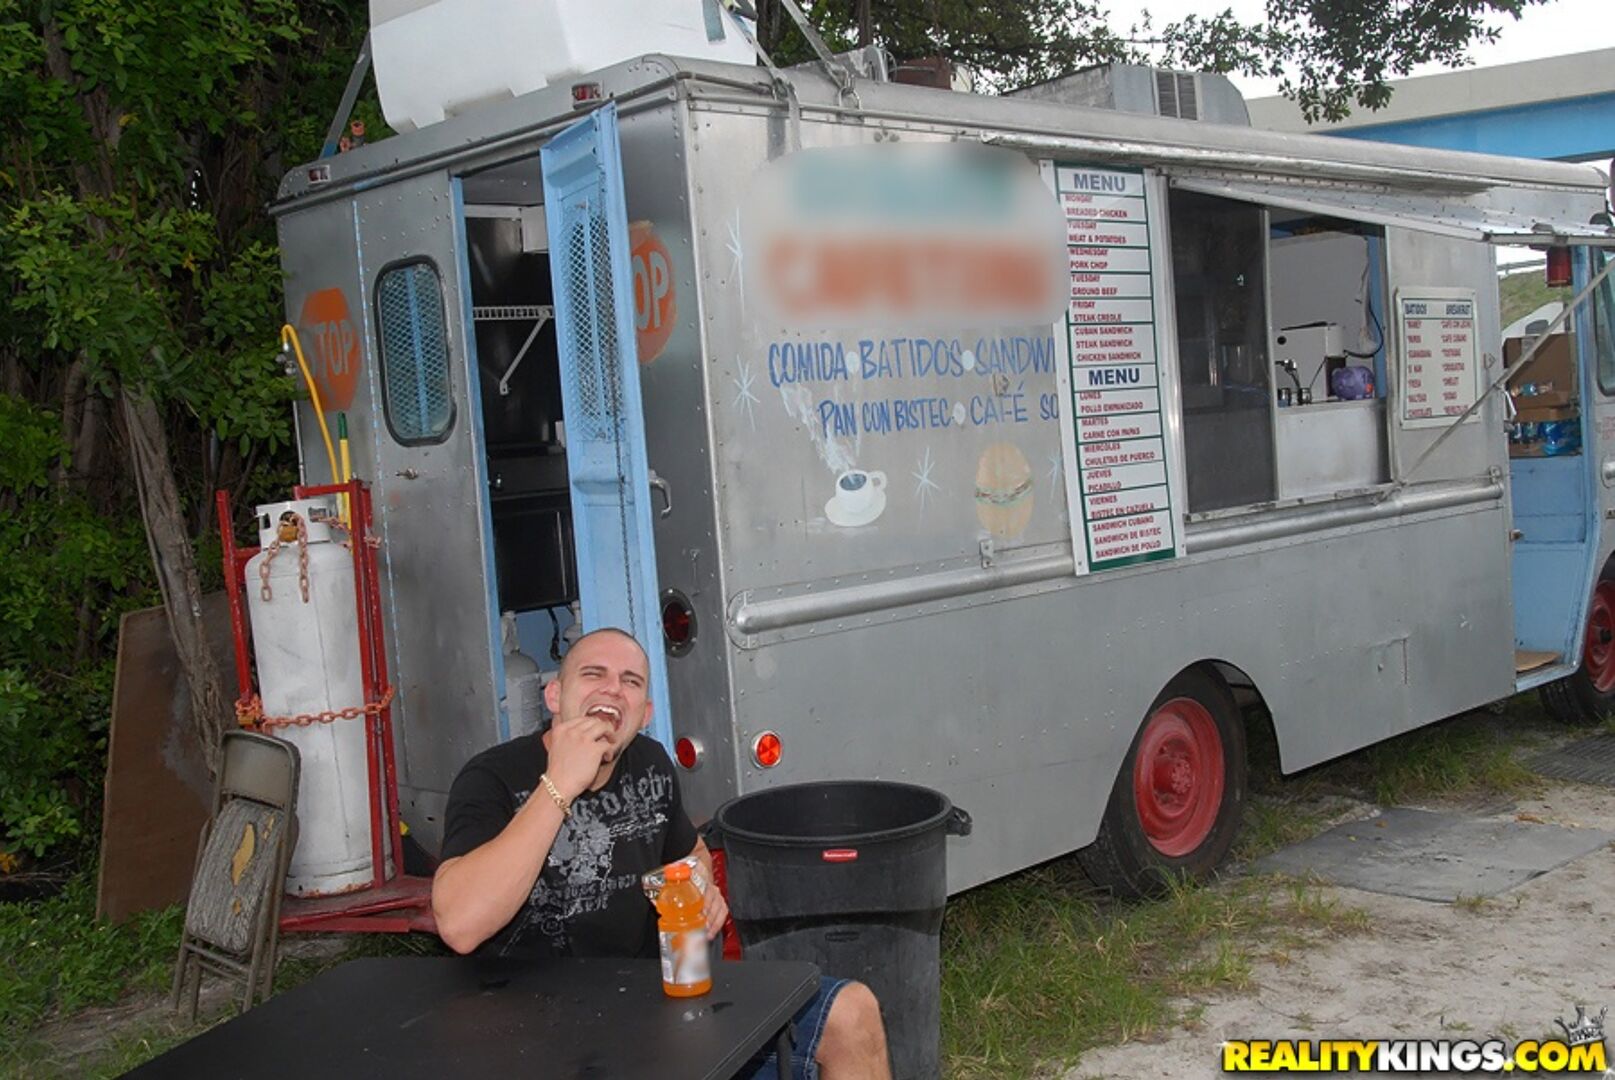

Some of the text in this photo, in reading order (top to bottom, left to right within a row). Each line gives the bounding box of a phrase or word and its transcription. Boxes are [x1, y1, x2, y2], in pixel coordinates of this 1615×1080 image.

[1073, 173, 1126, 192] MENU
[1099, 208, 1127, 218] CHICKEN
[1069, 234, 1086, 242] MEAT
[1069, 248, 1108, 256] WEDNESDAY
[1070, 260, 1108, 269] PORK CHOP
[1072, 274, 1100, 282] TUESDAY
[633, 250, 671, 331] OP
[1072, 287, 1118, 295] GROUND BEEF
[1072, 301, 1096, 309] FRIDAY
[1074, 314, 1096, 322] STEAK
[1074, 326, 1133, 335] CUBAN SANDWICH
[1076, 339, 1133, 349] STEAK SANDWICH
[1076, 352, 1142, 361] CHICKEN SANDWICH
[769, 336, 1057, 388] COMIDA BATIDOS SANDWI
[1088, 368, 1140, 386] MENU
[1080, 391, 1102, 400] LUNES
[1081, 405, 1102, 413] POLLO
[819, 399, 857, 438] PAN
[862, 398, 892, 436] CON
[894, 398, 951, 431] BISTEC
[1039, 393, 1060, 421] SO
[1081, 417, 1109, 426] MARTES
[1083, 431, 1105, 440] CARNE
[1106, 429, 1120, 437] CON
[1085, 451, 1155, 465] CHULETAS DE PUERCO
[1087, 469, 1112, 479] JUEVES
[1089, 495, 1117, 505] VIERNES
[1091, 508, 1114, 519] BISTEC
[1092, 515, 1154, 532] SANDWICH CUBANO
[1094, 527, 1162, 545] SANDWICH DE BISTEC
[1095, 540, 1161, 558] SANDWICH DE POLLO
